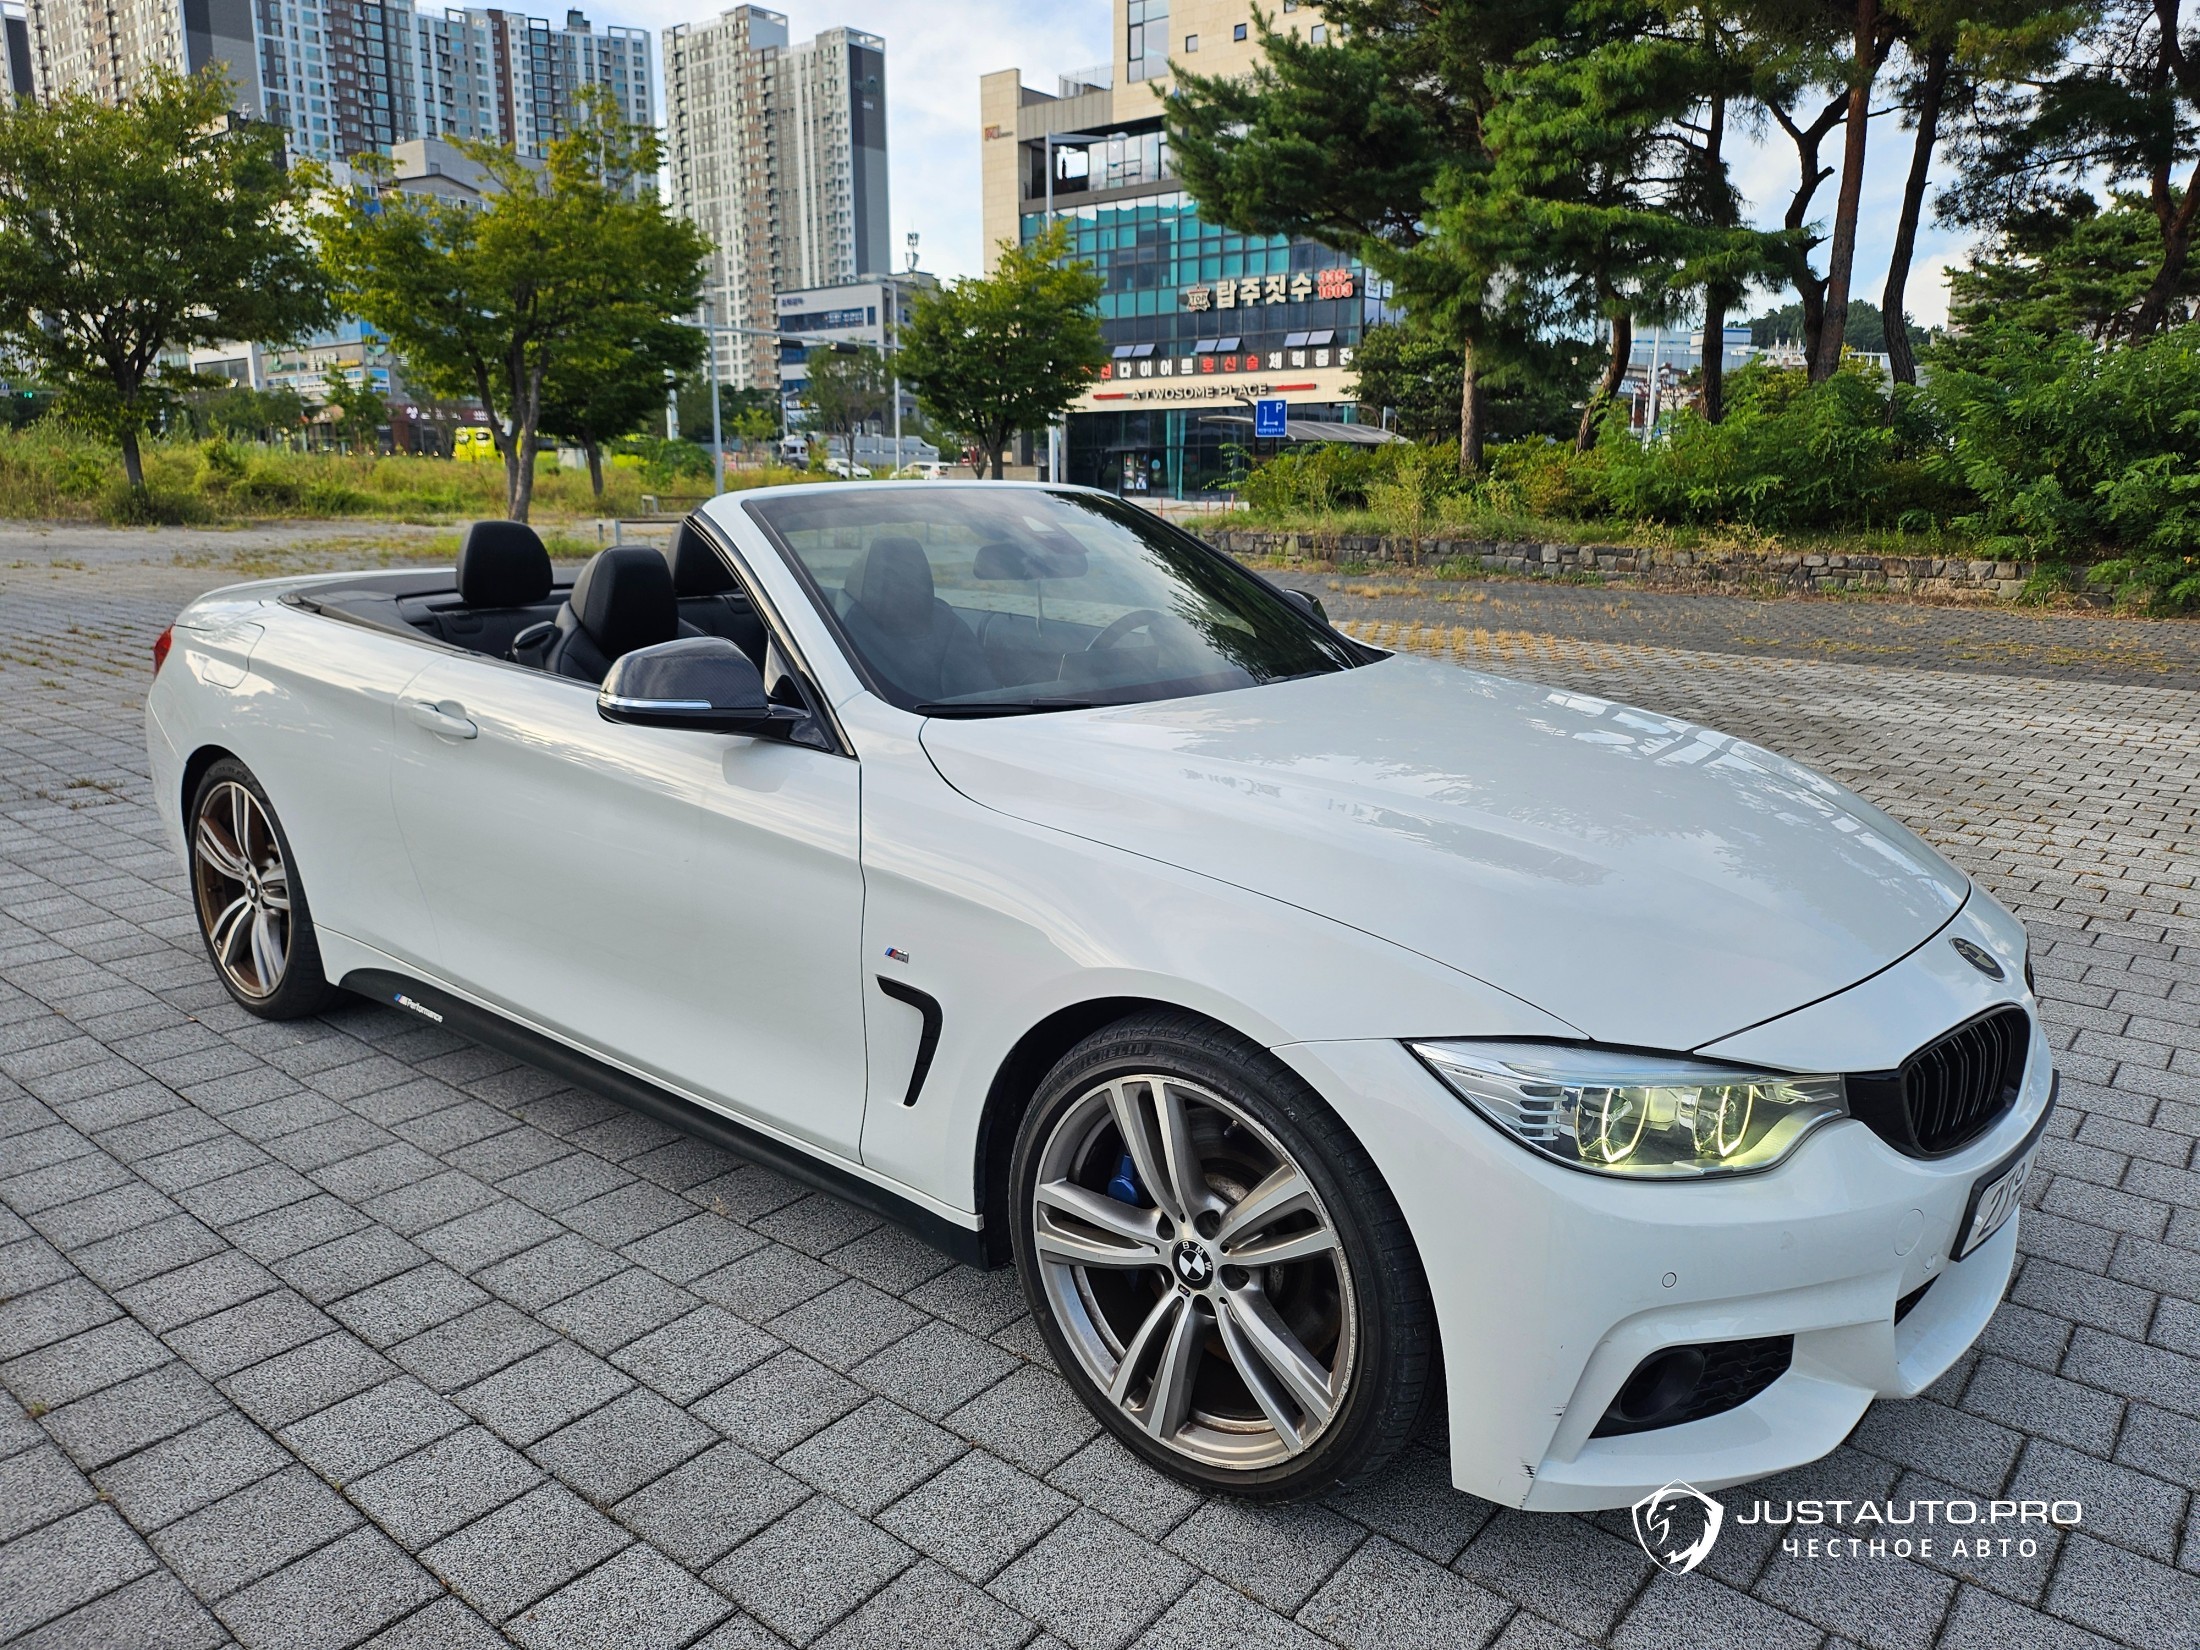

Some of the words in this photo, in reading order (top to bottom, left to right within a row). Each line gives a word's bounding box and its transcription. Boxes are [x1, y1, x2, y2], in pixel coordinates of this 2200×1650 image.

[1216, 272, 1313, 309] 탑주짓수
[1318, 282, 1353, 299] 1603
[1119, 358, 1194, 378] 다이어트
[1202, 355, 1259, 373] 호신술
[1132, 389, 1141, 401] A
[1144, 385, 1215, 400] TWOSOME
[1219, 382, 1268, 397] PLACE
[1276, 402, 1283, 413] P
[1182, 1241, 1212, 1271] BMW
